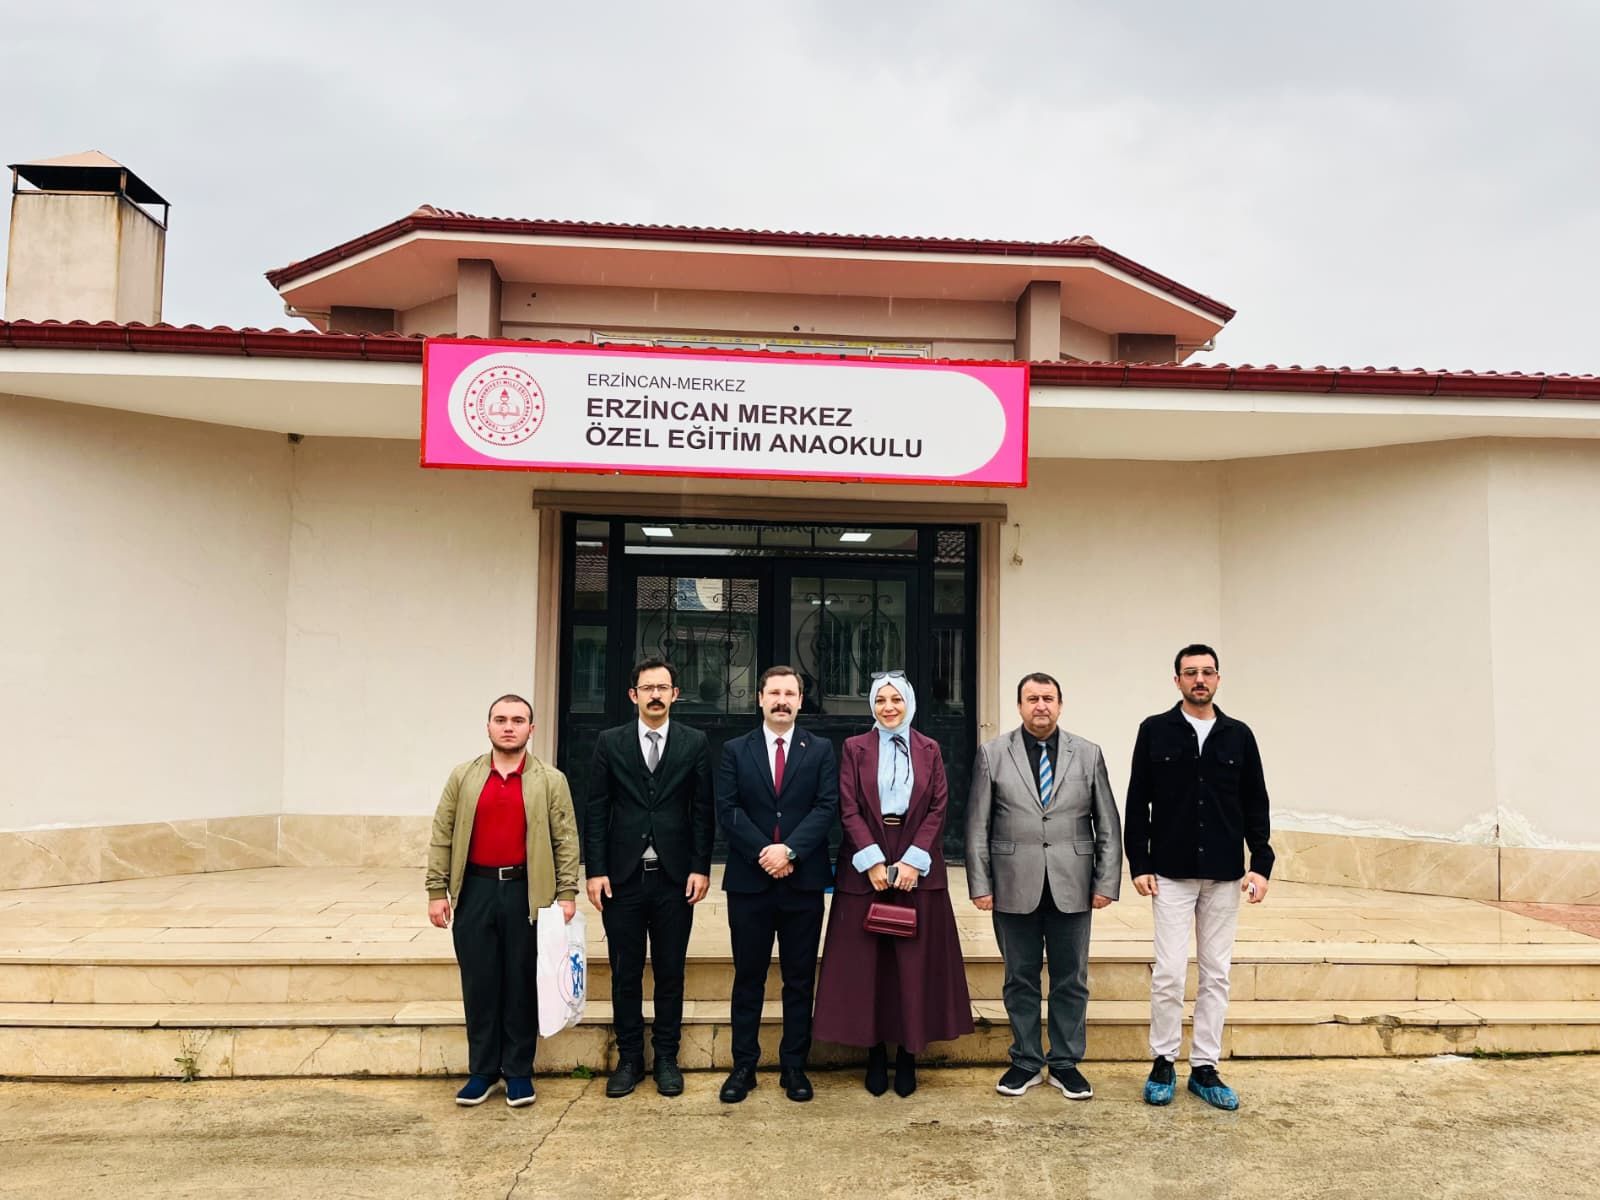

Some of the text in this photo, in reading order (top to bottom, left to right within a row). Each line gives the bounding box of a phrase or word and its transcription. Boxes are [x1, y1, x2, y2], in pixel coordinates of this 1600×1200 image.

[586, 371, 746, 394] ERZİNCAN-MERKEZ
[586, 395, 853, 428] ERZİNCAN MERKEZ
[585, 420, 922, 459] ÖZEL EĞİTİM ANAOKULU
